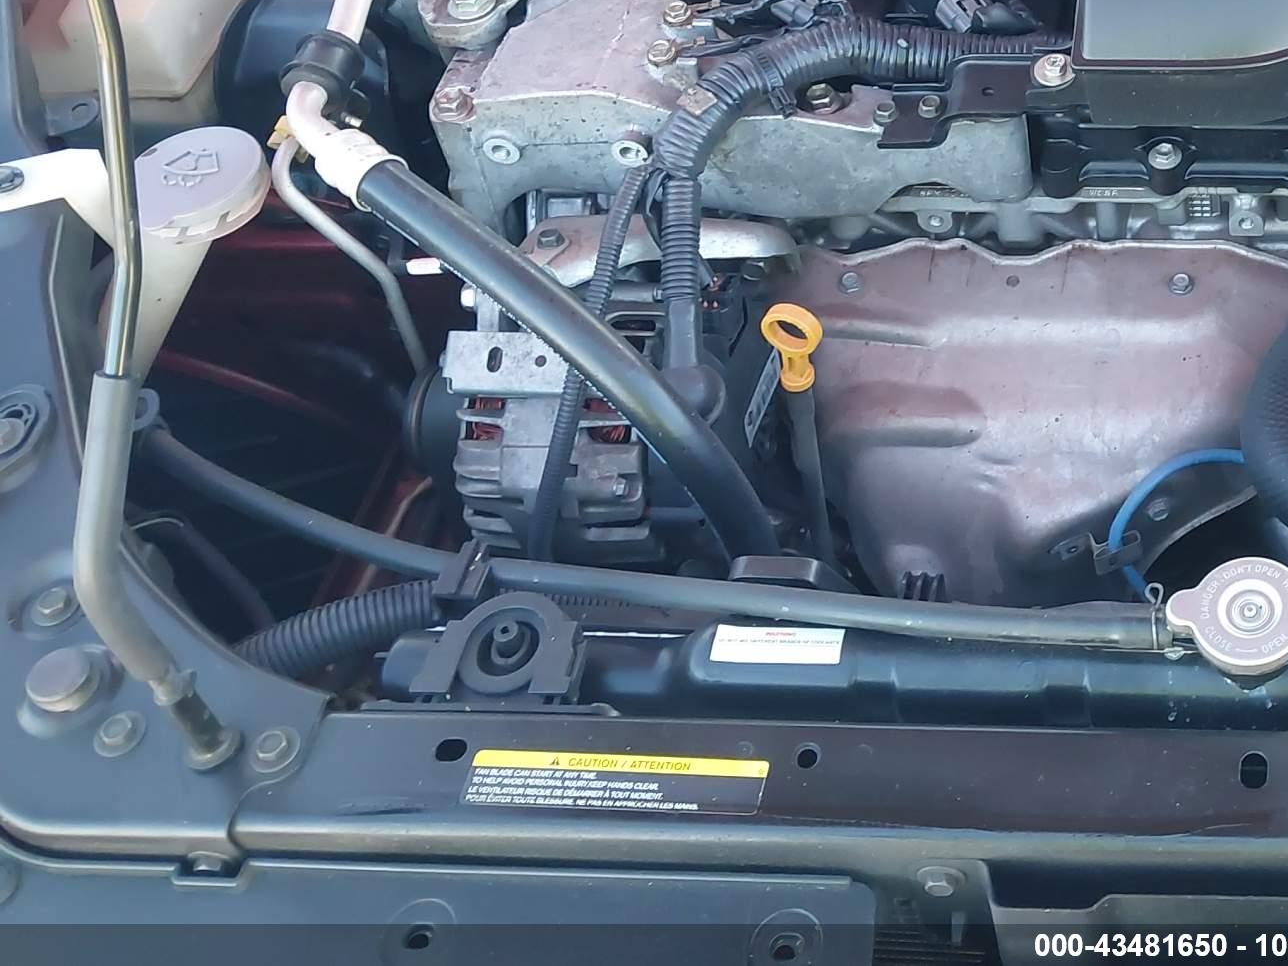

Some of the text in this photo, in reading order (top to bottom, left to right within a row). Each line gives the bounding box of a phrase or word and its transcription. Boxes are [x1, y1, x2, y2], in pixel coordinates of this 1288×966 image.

[1254, 564, 1281, 579] OPEN
[1199, 580, 1221, 620] DANGER
[1204, 625, 1233, 653] CLOSE
[568, 757, 618, 768] CAUTION
[629, 760, 692, 771] ATTENTION
[502, 777, 525, 785] AVOID
[524, 778, 563, 787] PERSONAL
